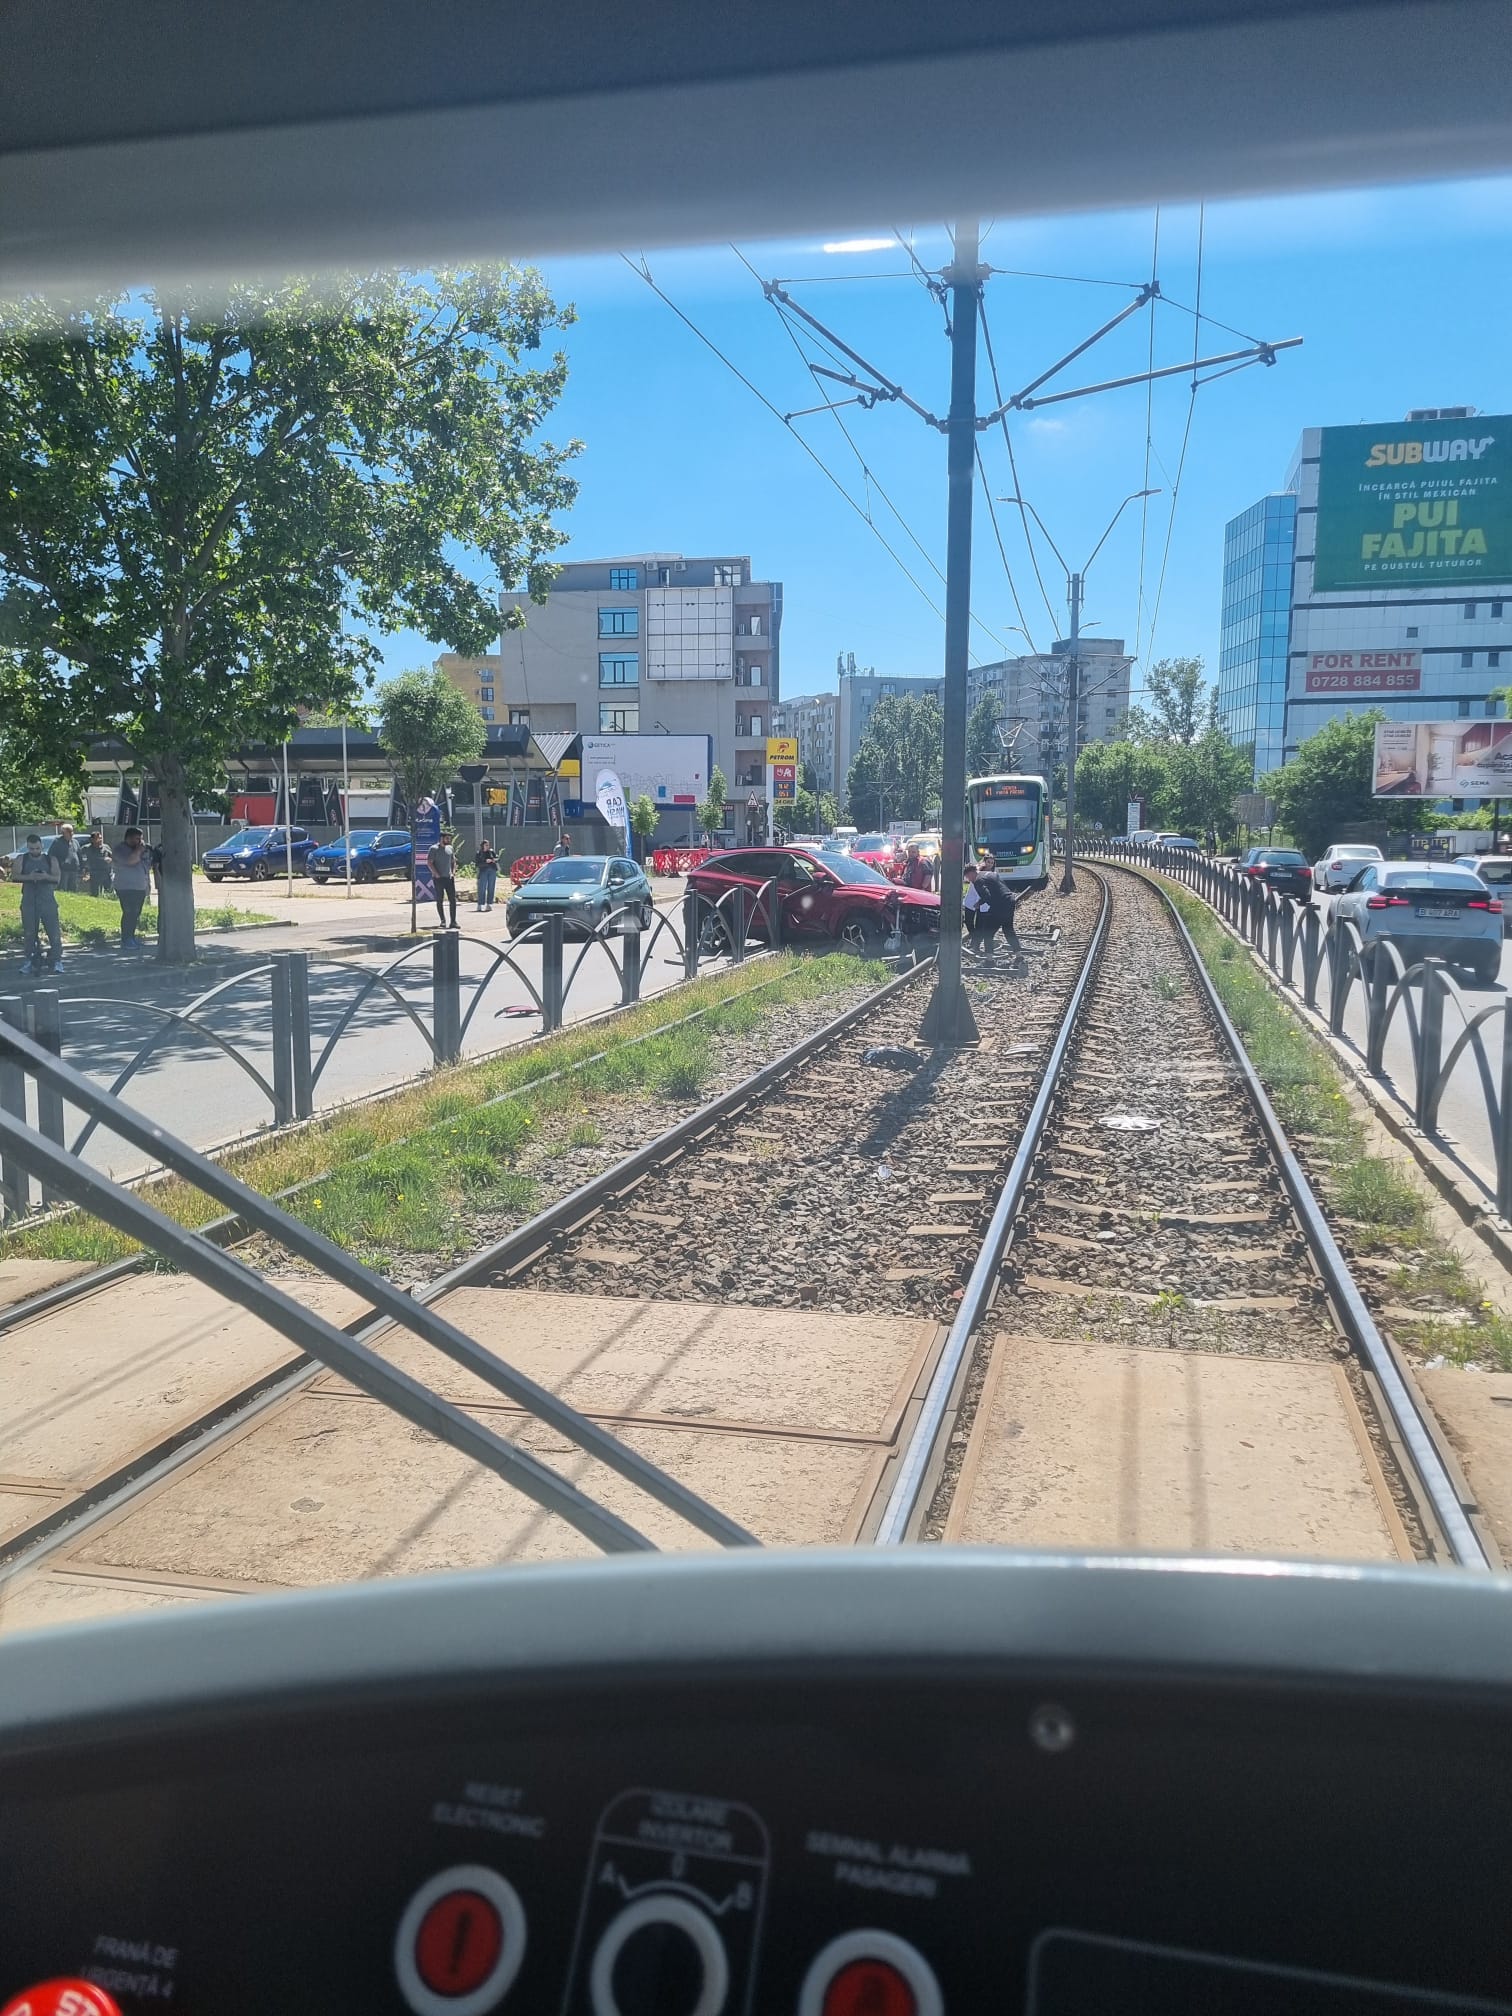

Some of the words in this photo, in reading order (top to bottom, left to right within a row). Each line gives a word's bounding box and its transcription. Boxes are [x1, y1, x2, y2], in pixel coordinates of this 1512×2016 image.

[1365, 435, 1495, 467] SUBWAY
[1420, 478, 1455, 489] PUIUL
[1459, 476, 1498, 487] FAJITA
[1394, 490, 1419, 500] STIL
[1423, 487, 1477, 498] MEXICAN
[1393, 500, 1459, 529] PUI
[1362, 528, 1487, 559] FAJITA
[1363, 563, 1377, 571] PE
[1311, 653, 1353, 670] FOR
[1359, 652, 1417, 668] RENT
[1311, 676, 1349, 688] 0728
[1353, 675, 1382, 687] 884
[1386, 674, 1415, 686] 855
